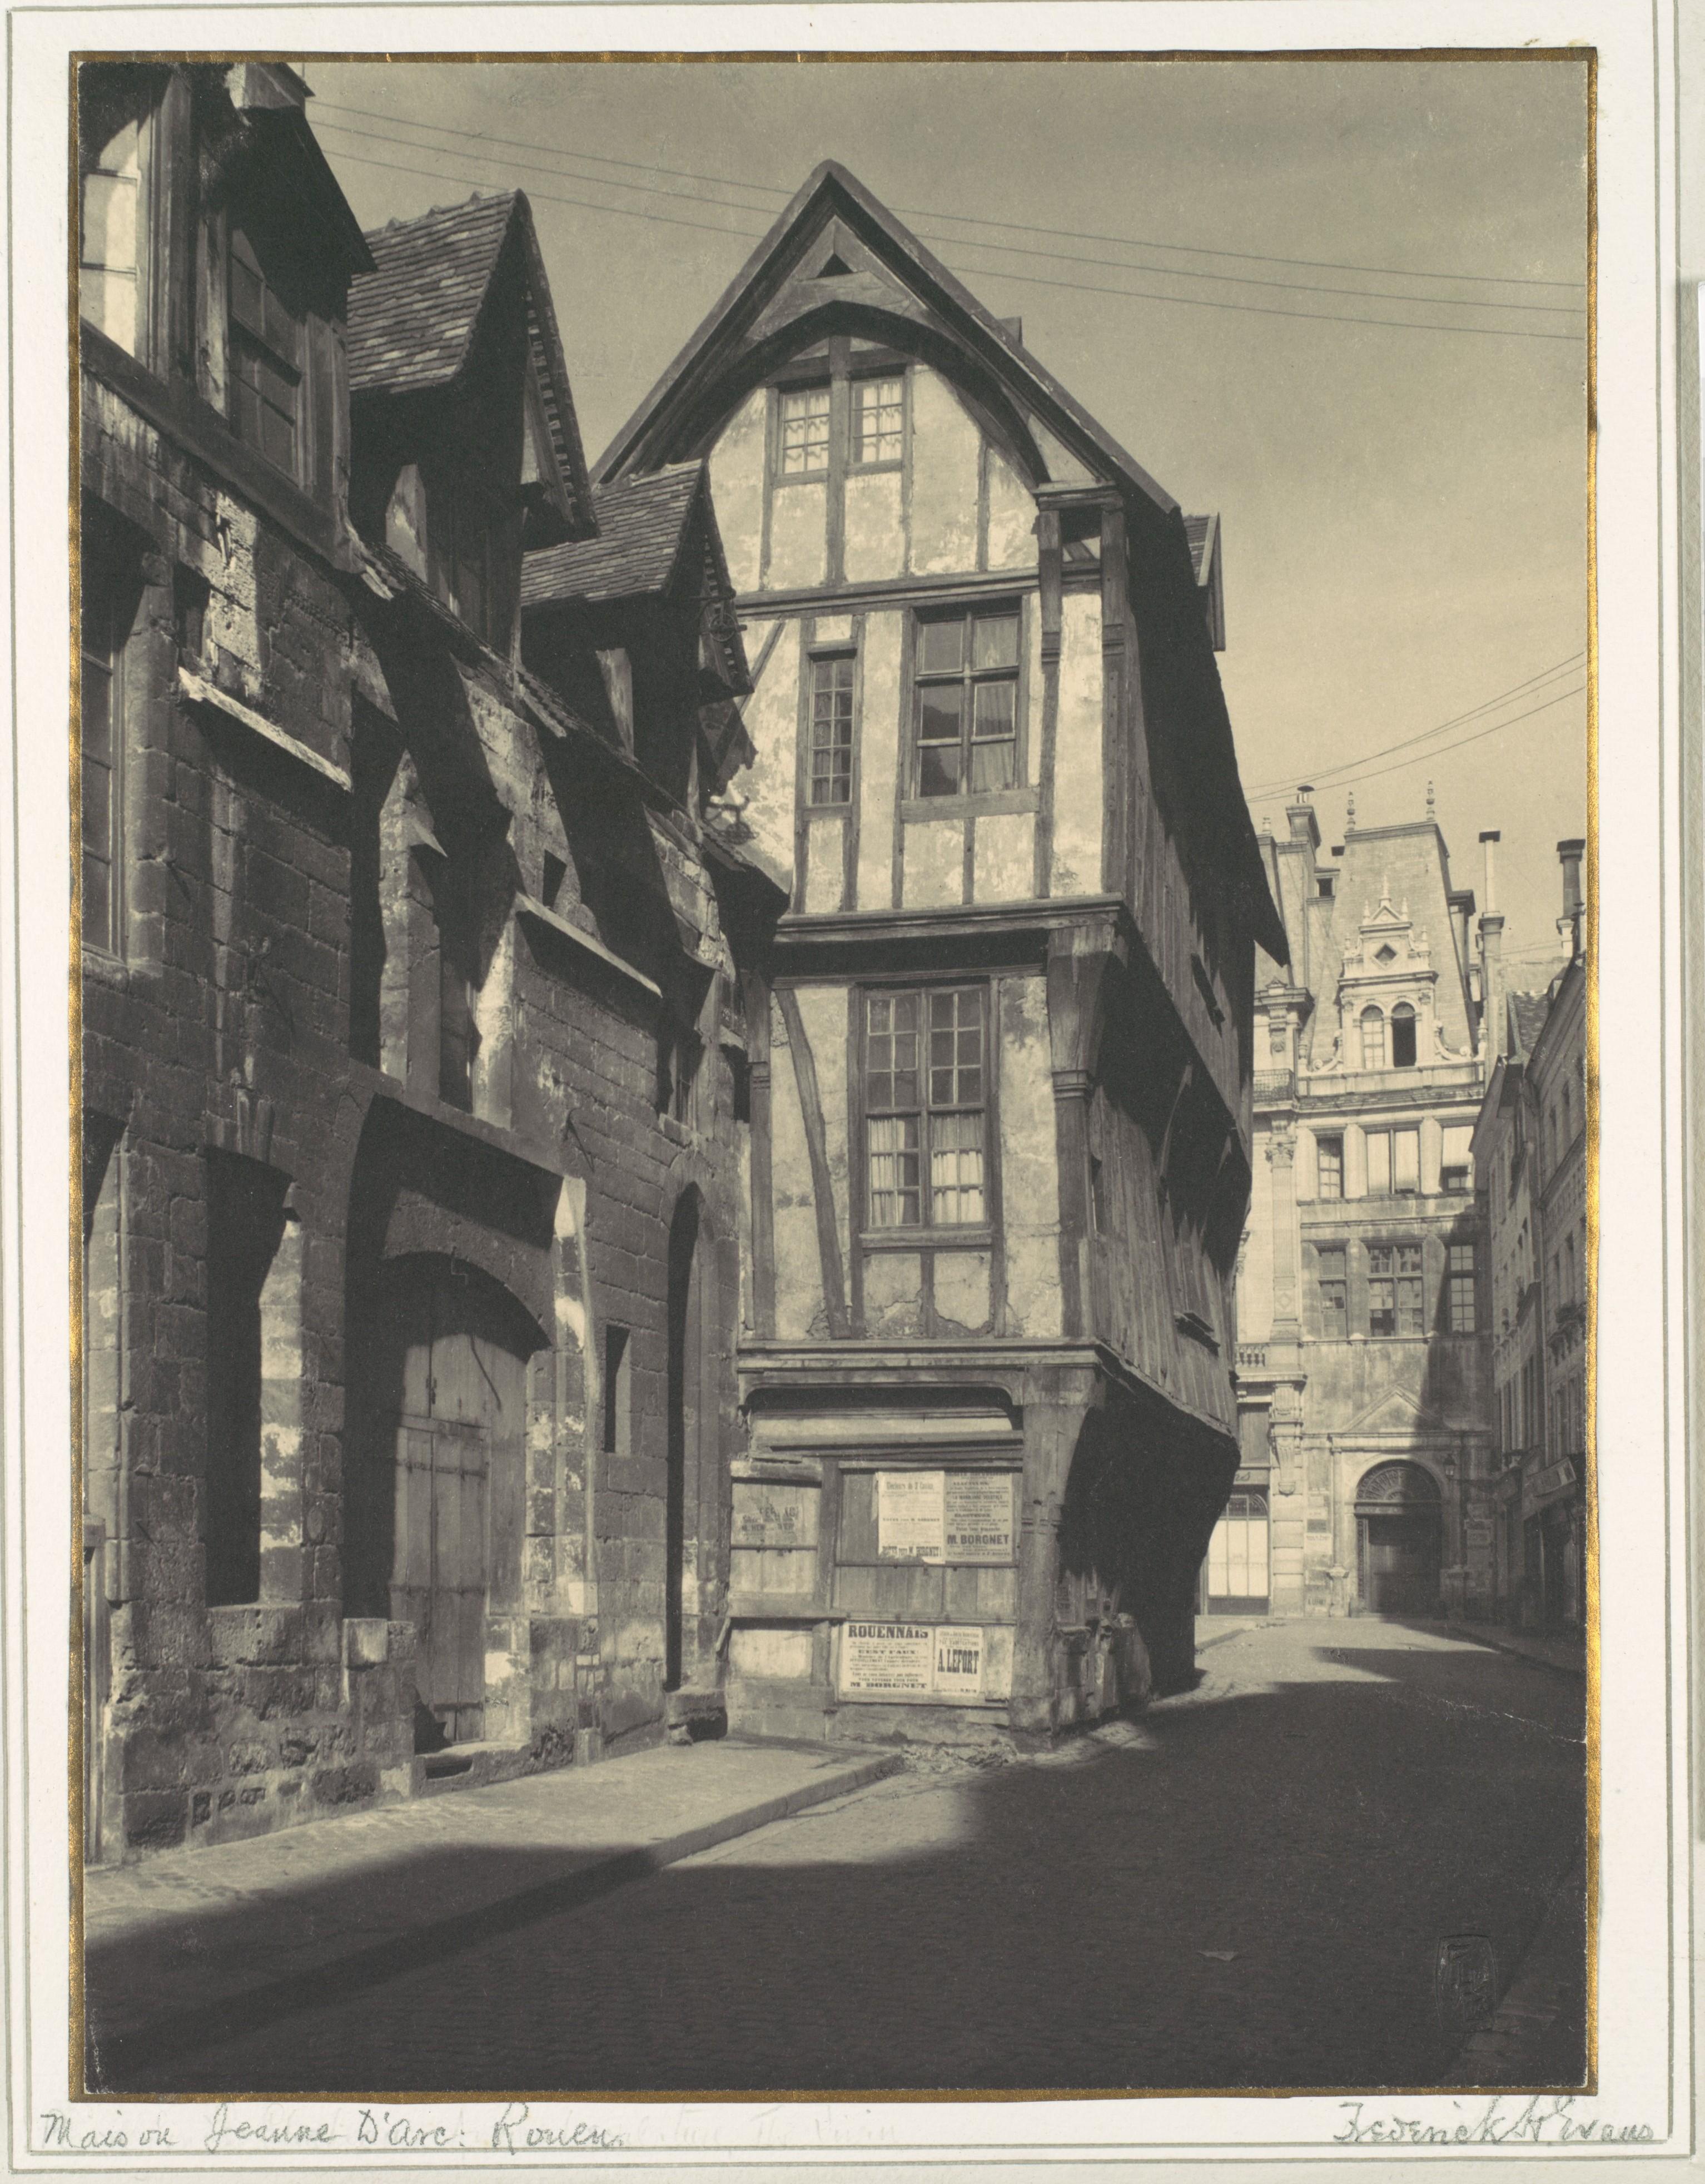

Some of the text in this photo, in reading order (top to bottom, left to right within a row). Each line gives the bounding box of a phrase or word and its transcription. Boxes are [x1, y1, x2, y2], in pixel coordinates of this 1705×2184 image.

[947, 1534, 1009, 1545] M. BORGNET
[848, 1625, 928, 1639] ROUENNAIS
[946, 1649, 979, 1674] LEFORT
[41, 2109, 180, 2150] Maison
[203, 2102, 346, 2155] Jeanne
[1333, 2096, 1507, 2145] Frederick
